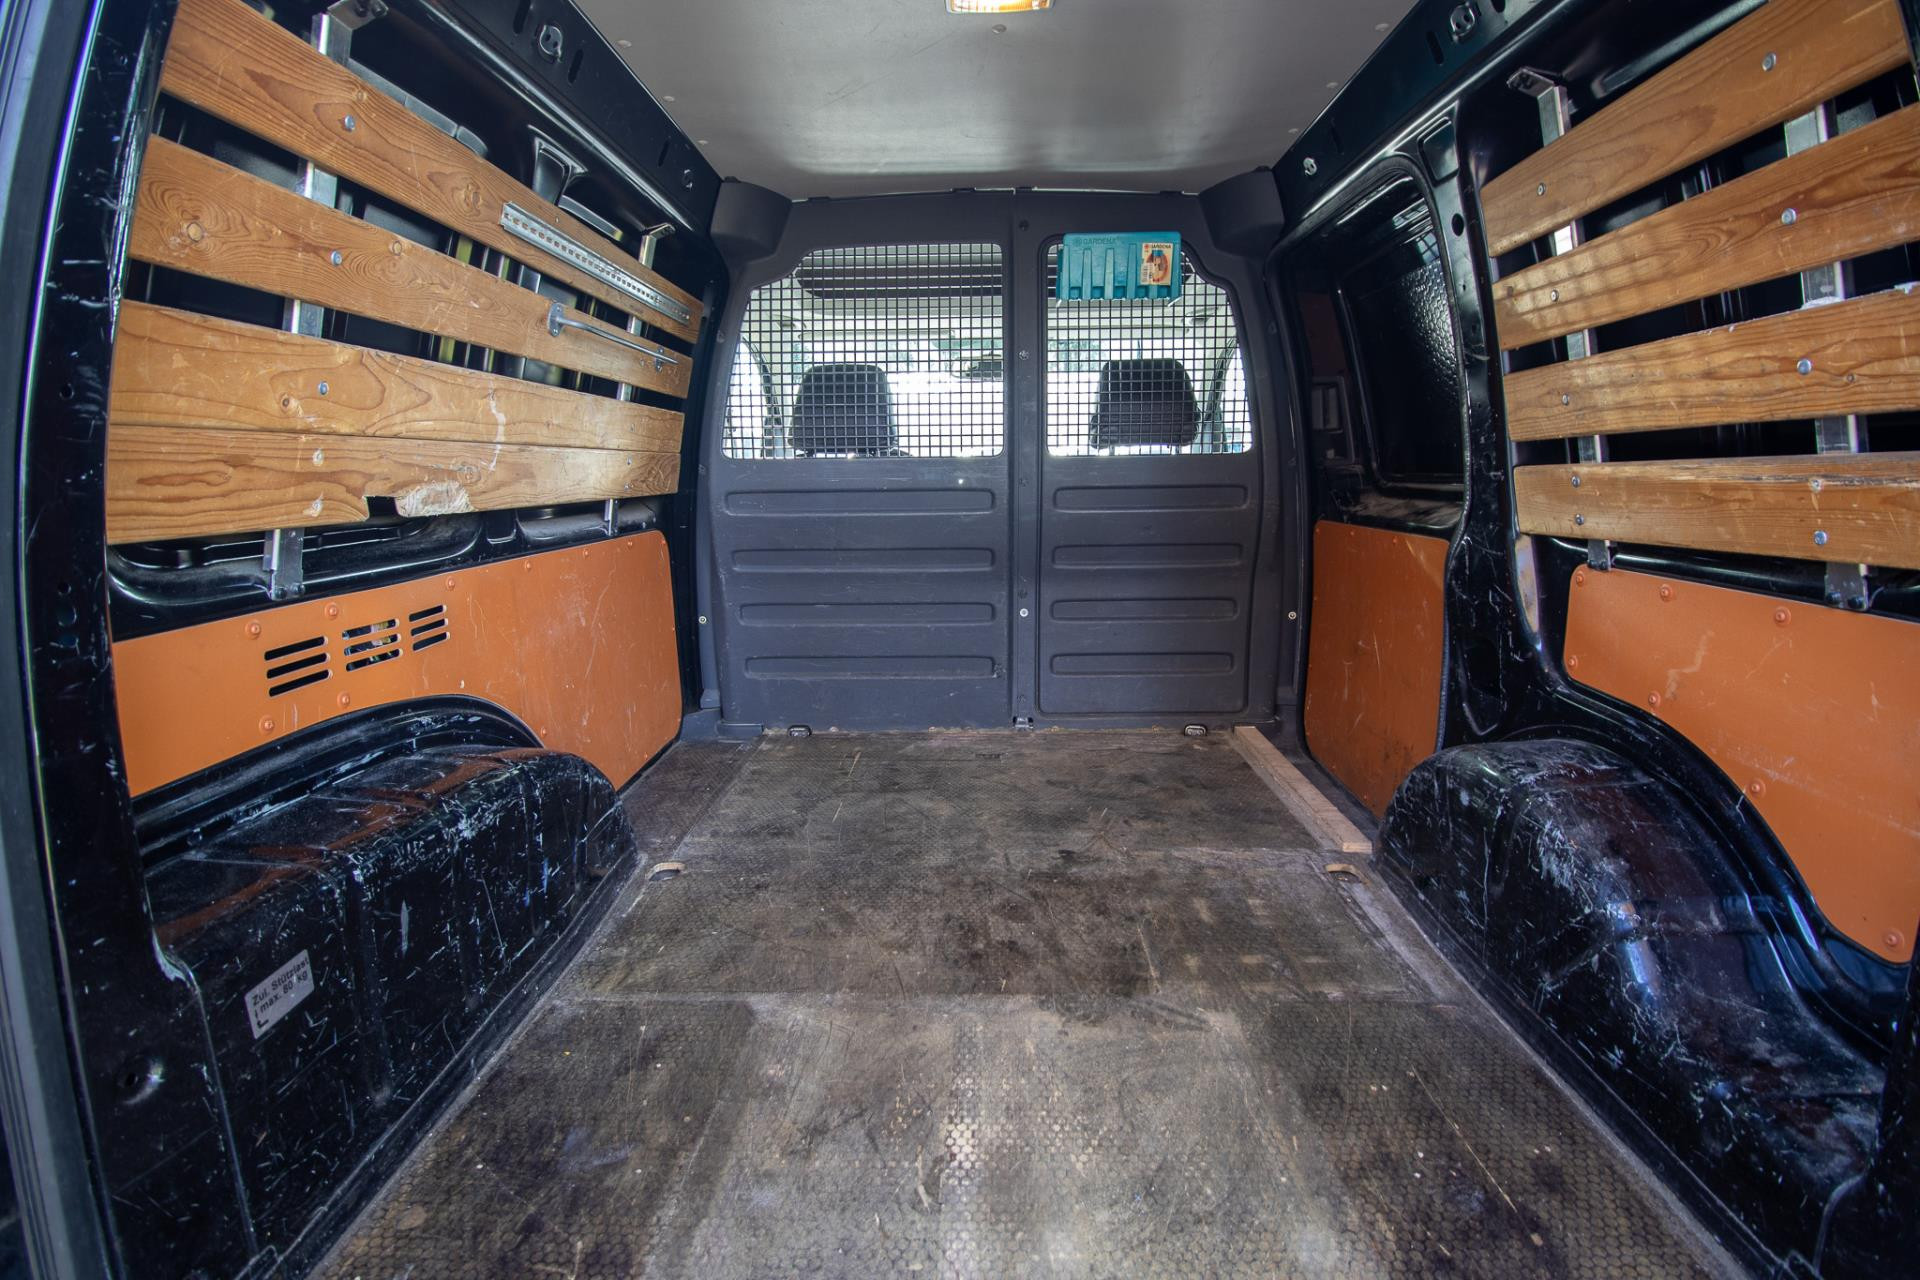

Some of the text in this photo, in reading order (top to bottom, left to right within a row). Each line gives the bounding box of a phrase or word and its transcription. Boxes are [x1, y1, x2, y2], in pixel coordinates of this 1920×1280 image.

[1083, 237, 1117, 245] GARDENA
[252, 956, 310, 1006] Zul. Stützlast
[260, 994, 282, 1013] max.
